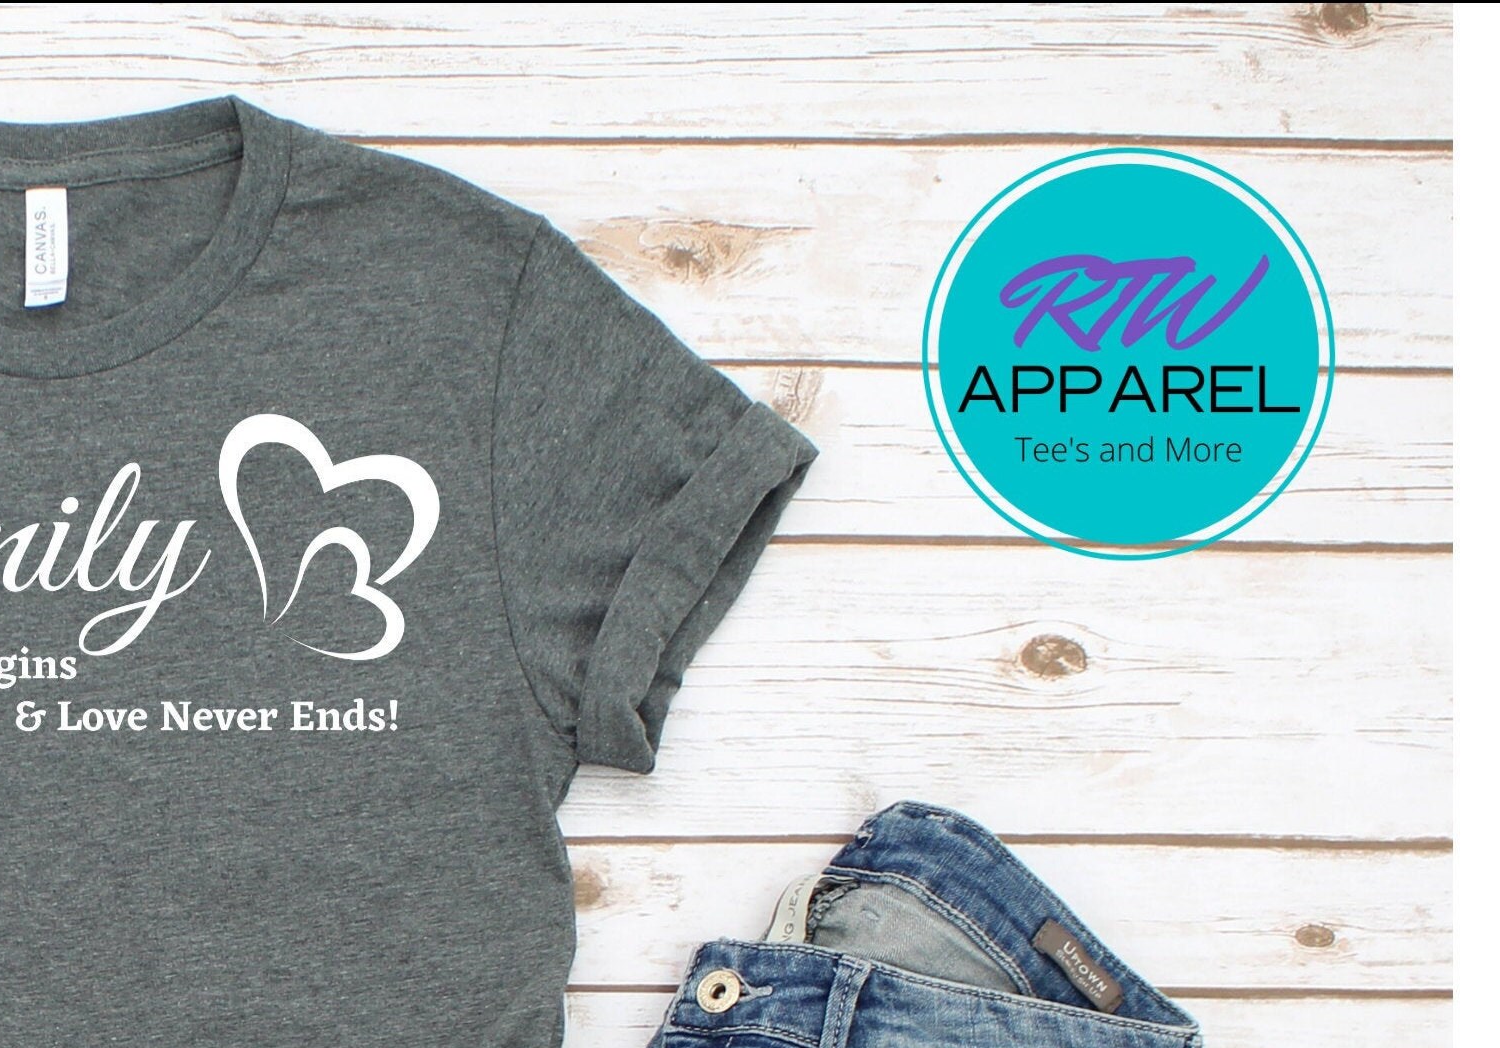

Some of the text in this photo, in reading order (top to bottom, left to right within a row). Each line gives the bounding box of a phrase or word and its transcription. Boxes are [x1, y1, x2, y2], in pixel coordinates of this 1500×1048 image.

[15, 697, 398, 732] & Love Never Ends!
